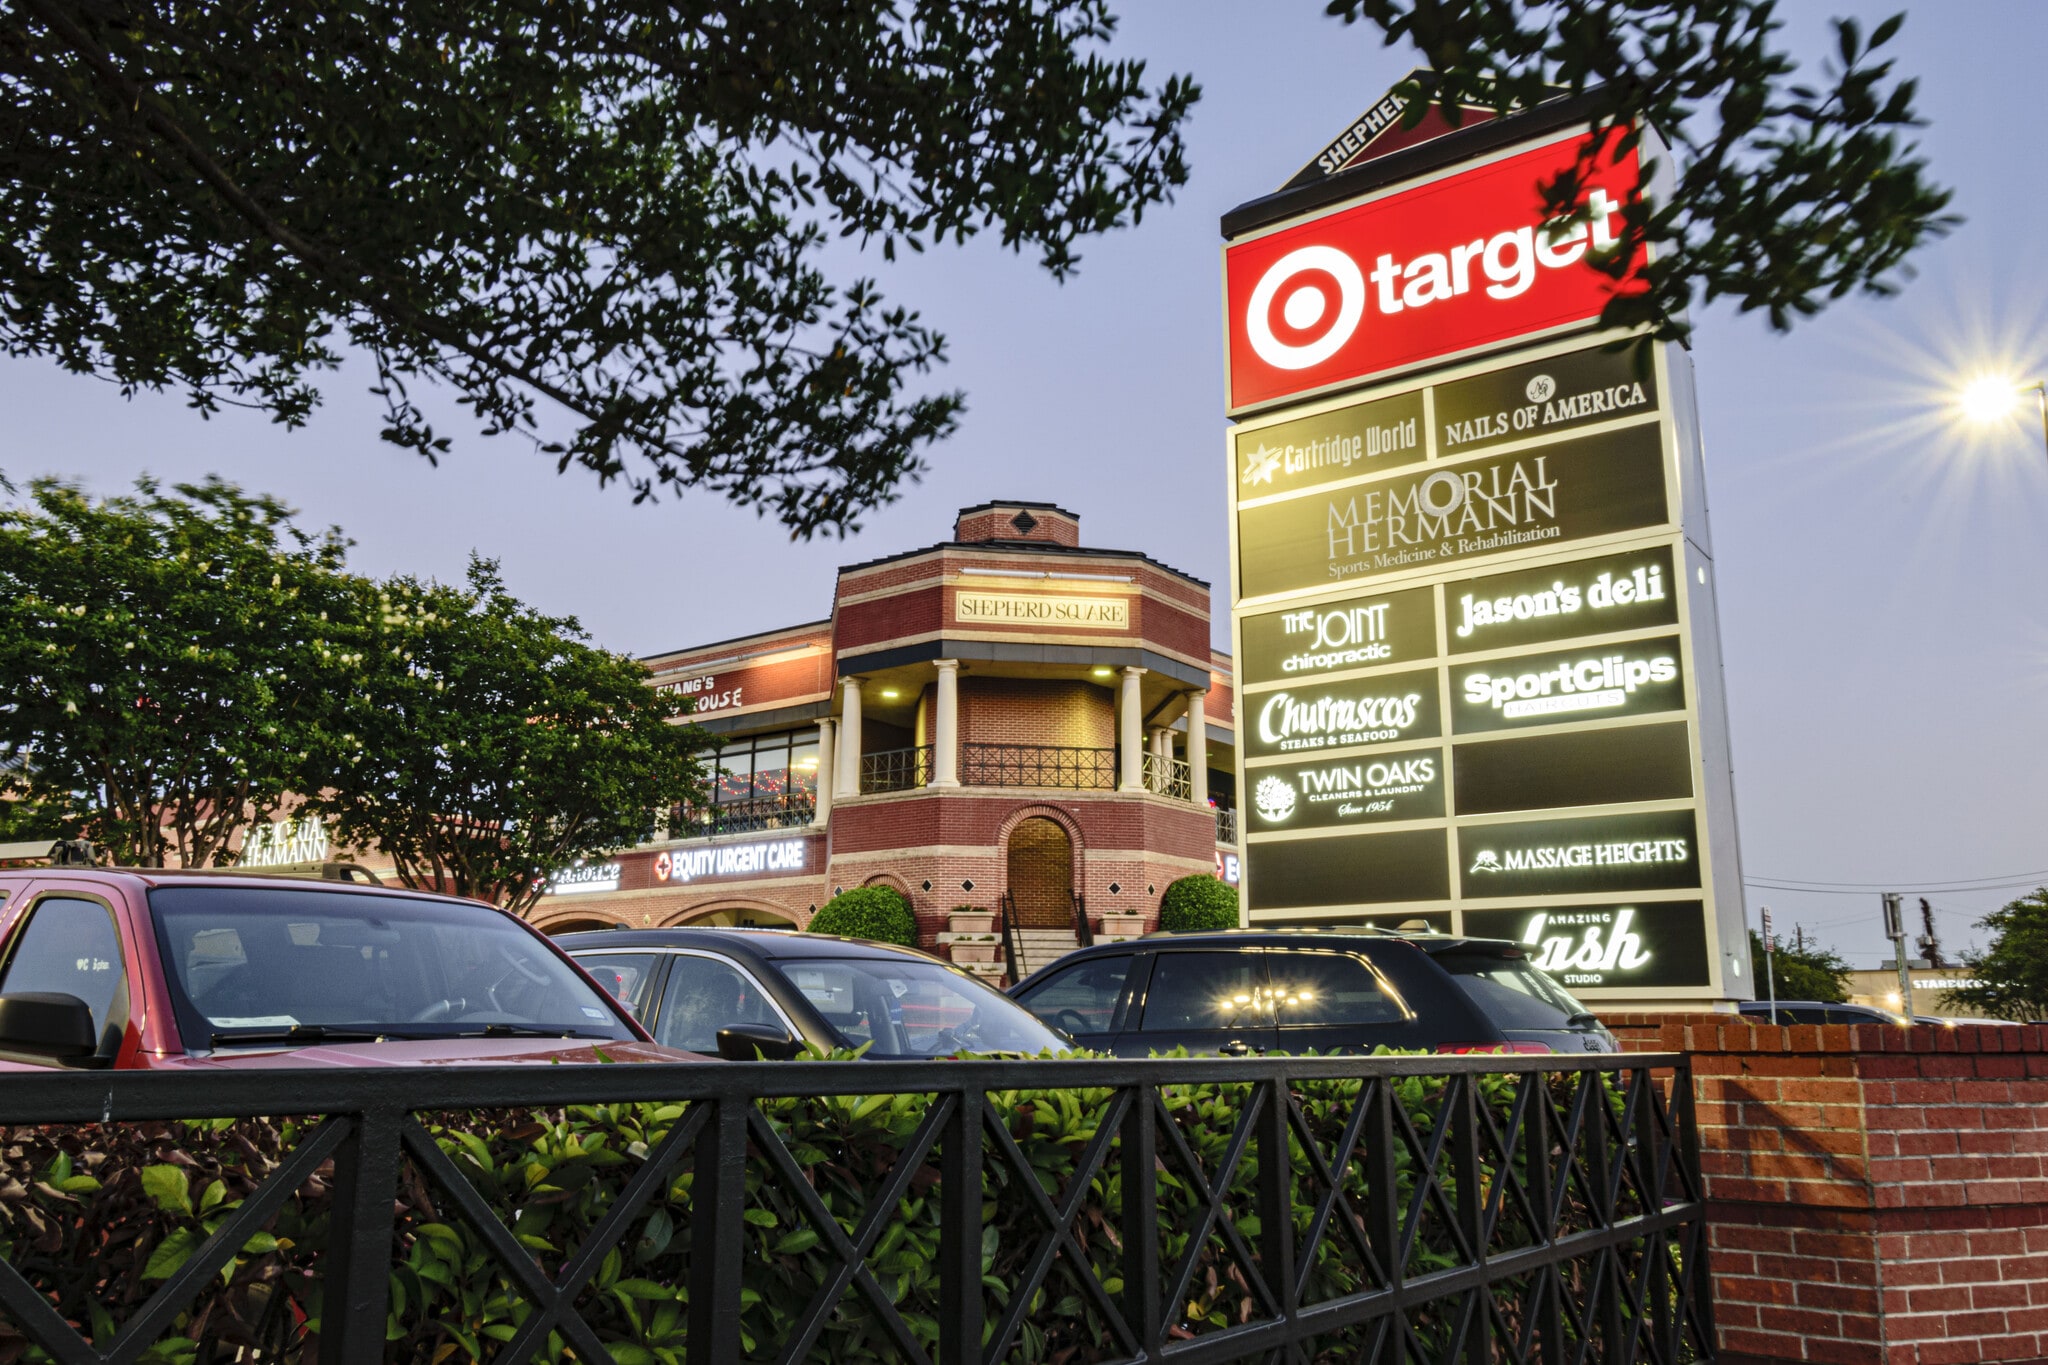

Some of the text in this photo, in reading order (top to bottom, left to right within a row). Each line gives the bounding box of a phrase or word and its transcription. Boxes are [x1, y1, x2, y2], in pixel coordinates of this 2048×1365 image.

[1318, 79, 1421, 174] SHEPHER
[1370, 188, 1620, 315] target
[1445, 412, 1509, 446] NAILS
[1512, 404, 1539, 431] OF
[1542, 381, 1647, 425] AMERICA
[1284, 417, 1417, 475] Cartridge World
[1326, 456, 1558, 532] MEMORIAL
[1328, 485, 1556, 559] HERMANN
[1328, 524, 1561, 580] Sports Medicine & Rehabilitation
[962, 598, 1123, 622] SHEPHERD SQUARE
[1456, 565, 1665, 637] Jason's deli
[1310, 603, 1390, 650] JOINT
[1282, 643, 1391, 671] chiropractic
[693, 687, 742, 712] OUSE
[1464, 655, 1677, 708] SportClips
[1259, 693, 1421, 743] Churrascos
[1280, 729, 1398, 751] STEAKS & SEAFOOD
[1299, 758, 1434, 794] TWIN OAKS
[1309, 785, 1424, 802] CLEANERS & LAUNDRY
[1338, 804, 1363, 817] Since
[672, 841, 804, 881] EQUITY URGENT CARE
[1504, 840, 1687, 871] MASSAGE HEIGHTS
[1548, 913, 1611, 925] AMAZING
[1564, 974, 1602, 984] STUDIO
